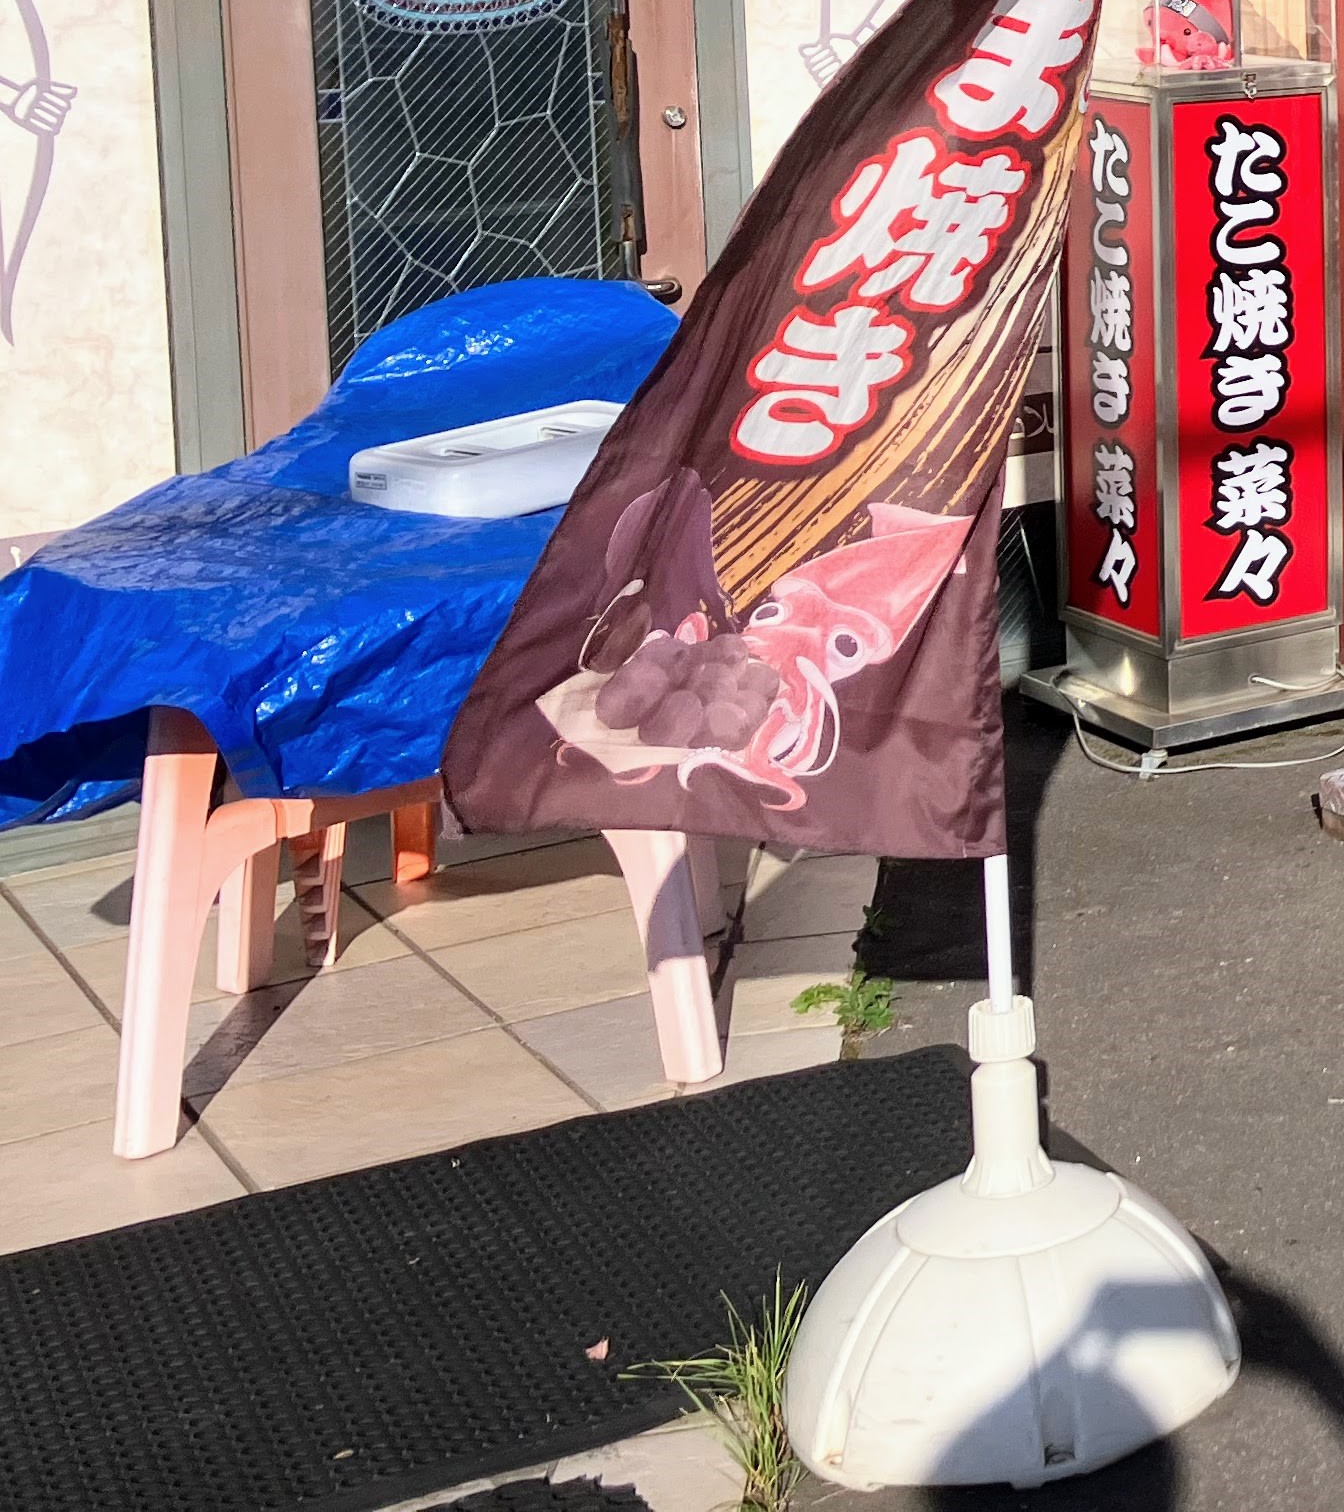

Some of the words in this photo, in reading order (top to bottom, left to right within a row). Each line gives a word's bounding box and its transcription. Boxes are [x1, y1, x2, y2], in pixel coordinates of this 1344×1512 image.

[1088, 115, 1133, 428] たこ焼き
[1206, 116, 1291, 430] たこ焼き
[1094, 443, 1136, 604] 菜々
[1208, 443, 1292, 602] 菜々
